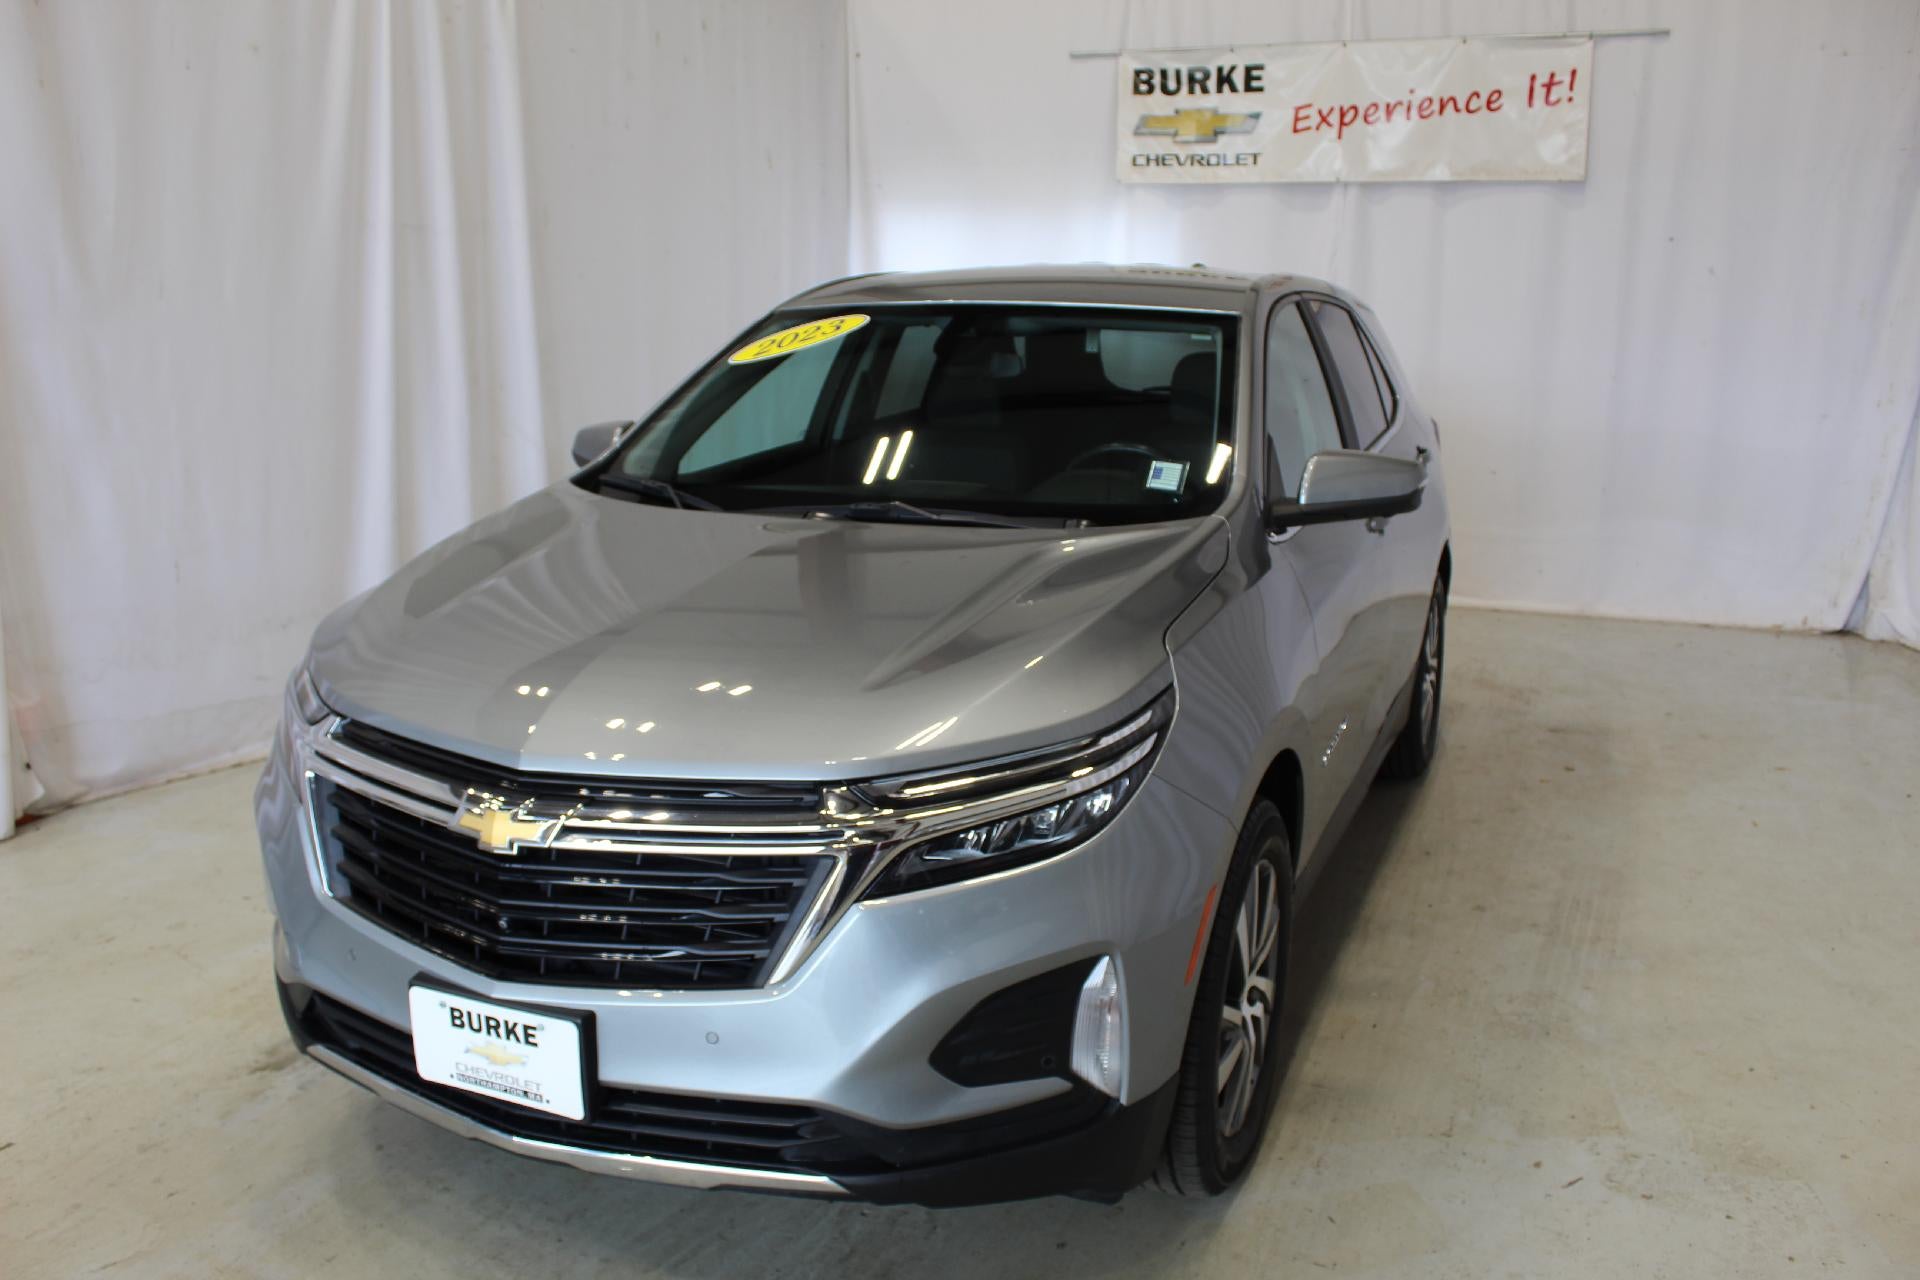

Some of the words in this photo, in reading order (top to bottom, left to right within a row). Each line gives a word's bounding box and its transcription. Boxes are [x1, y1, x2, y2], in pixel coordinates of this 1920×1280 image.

[1132, 63, 1266, 97] BURKE
[1291, 86, 1505, 141] Experience
[1525, 68, 1579, 109] It!
[1131, 152, 1262, 168] CHEVROLET
[752, 318, 845, 358] 2023
[450, 1006, 539, 1048] BURKE
[455, 1061, 543, 1093] CHEVROLET
